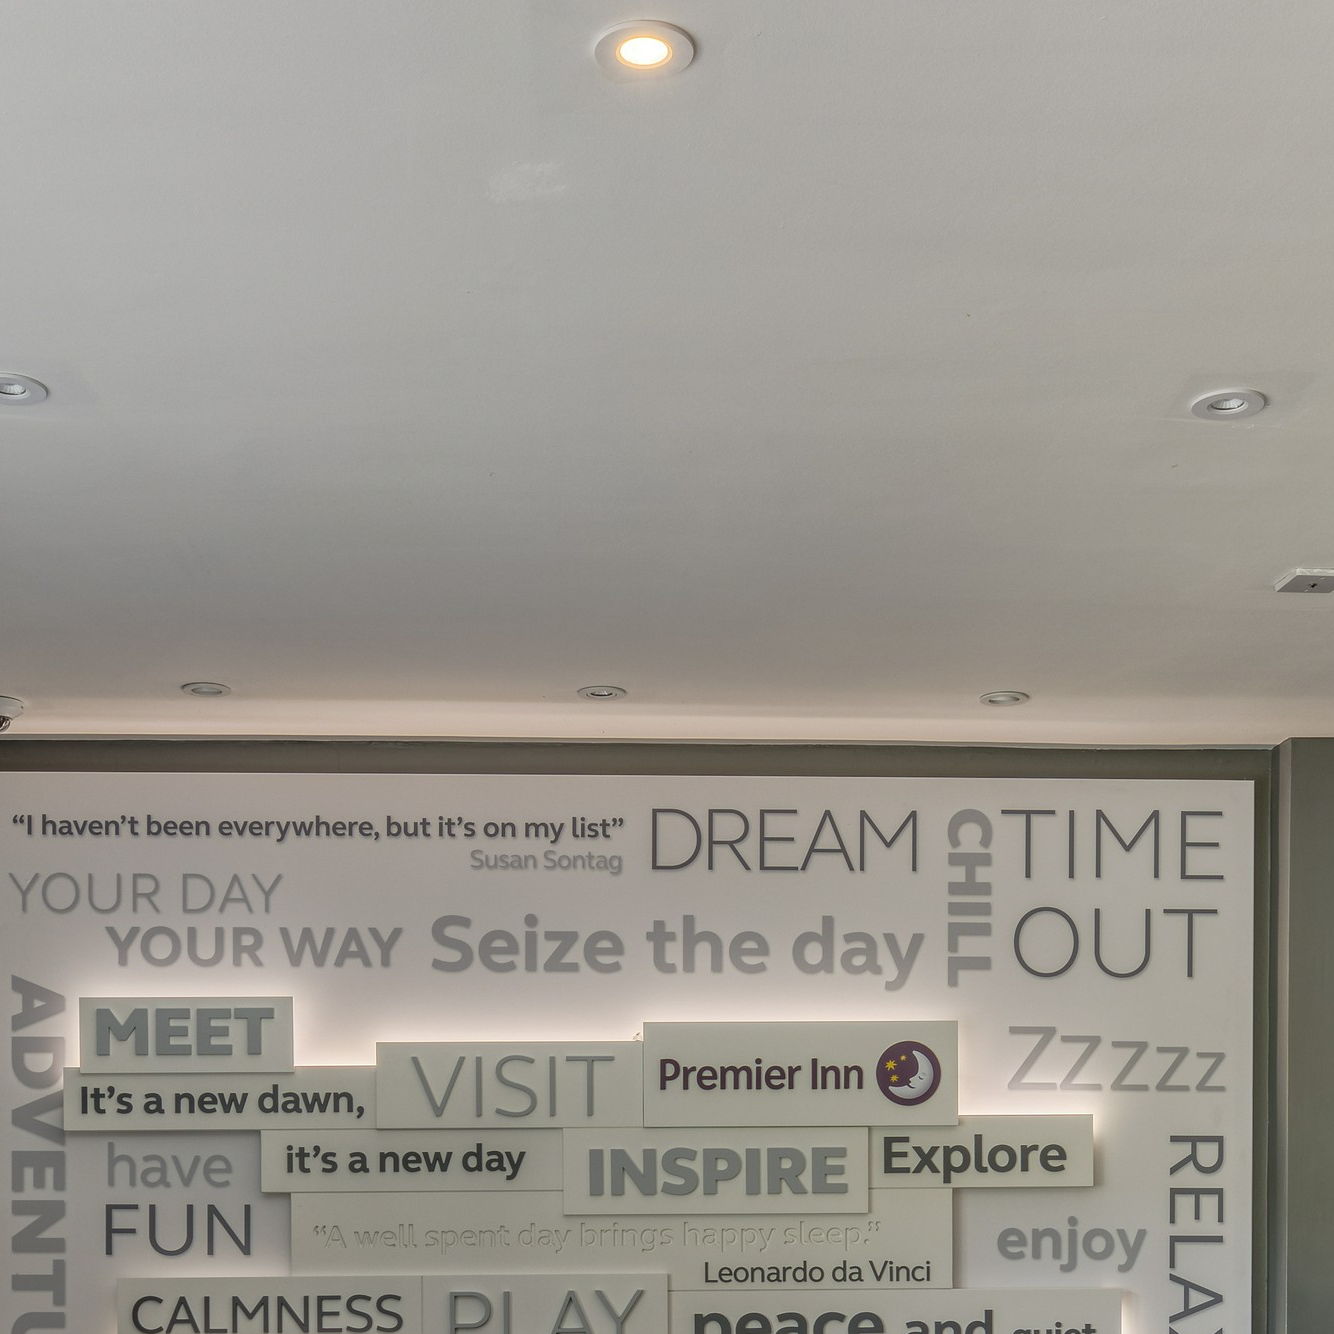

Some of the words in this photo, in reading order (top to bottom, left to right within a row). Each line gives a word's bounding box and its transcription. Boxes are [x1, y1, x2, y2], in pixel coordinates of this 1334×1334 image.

[42, 814, 139, 836] haven’t
[147, 815, 210, 836] been
[218, 815, 379, 842] everywhere,
[387, 816, 430, 837] but
[439, 816, 475, 837] it’s
[484, 822, 516, 837] on
[525, 823, 564, 844] my
[572, 817, 623, 838] list”
[652, 809, 917, 872] DREAM
[1001, 809, 1224, 880] TIME
[470, 849, 538, 871] Susan
[544, 850, 623, 876] Sontag
[8, 872, 160, 914] YOUR
[182, 873, 283, 914] DAY
[948, 809, 993, 987] CHILL
[104, 926, 263, 966] YOUR
[279, 927, 403, 968] WAY
[432, 914, 624, 973] Seize
[646, 915, 769, 973] the
[792, 915, 925, 990] day
[1014, 907, 1218, 978] OUT
[95, 1008, 274, 1057] MEET
[411, 1055, 615, 1119] VISIT
[660, 1058, 801, 1090] Premier
[812, 1058, 863, 1089] Inn
[81, 1086, 133, 1114] It’s
[144, 1093, 165, 1114] a
[175, 1093, 248, 1113] new
[258, 1084, 364, 1119] dawn,
[108, 1142, 232, 1188] have
[287, 1145, 338, 1173] it’s
[349, 1152, 369, 1173] a
[380, 1152, 453, 1173] new
[462, 1143, 526, 1180] day
[588, 1146, 848, 1197] INSPIRE
[884, 1134, 1066, 1184] Explore
[106, 1204, 251, 1256] FUN
[354, 1222, 417, 1249] well
[423, 1222, 513, 1254] spent
[520, 1221, 570, 1255] day
[577, 1220, 674, 1253] brings
[681, 1219, 776, 1254] happy
[997, 1216, 1147, 1273] enjoy
[705, 1261, 824, 1283] Leonardo
[832, 1260, 864, 1282] da
[869, 1261, 930, 1282] Vinci
[132, 1294, 403, 1334] CALMNESS
